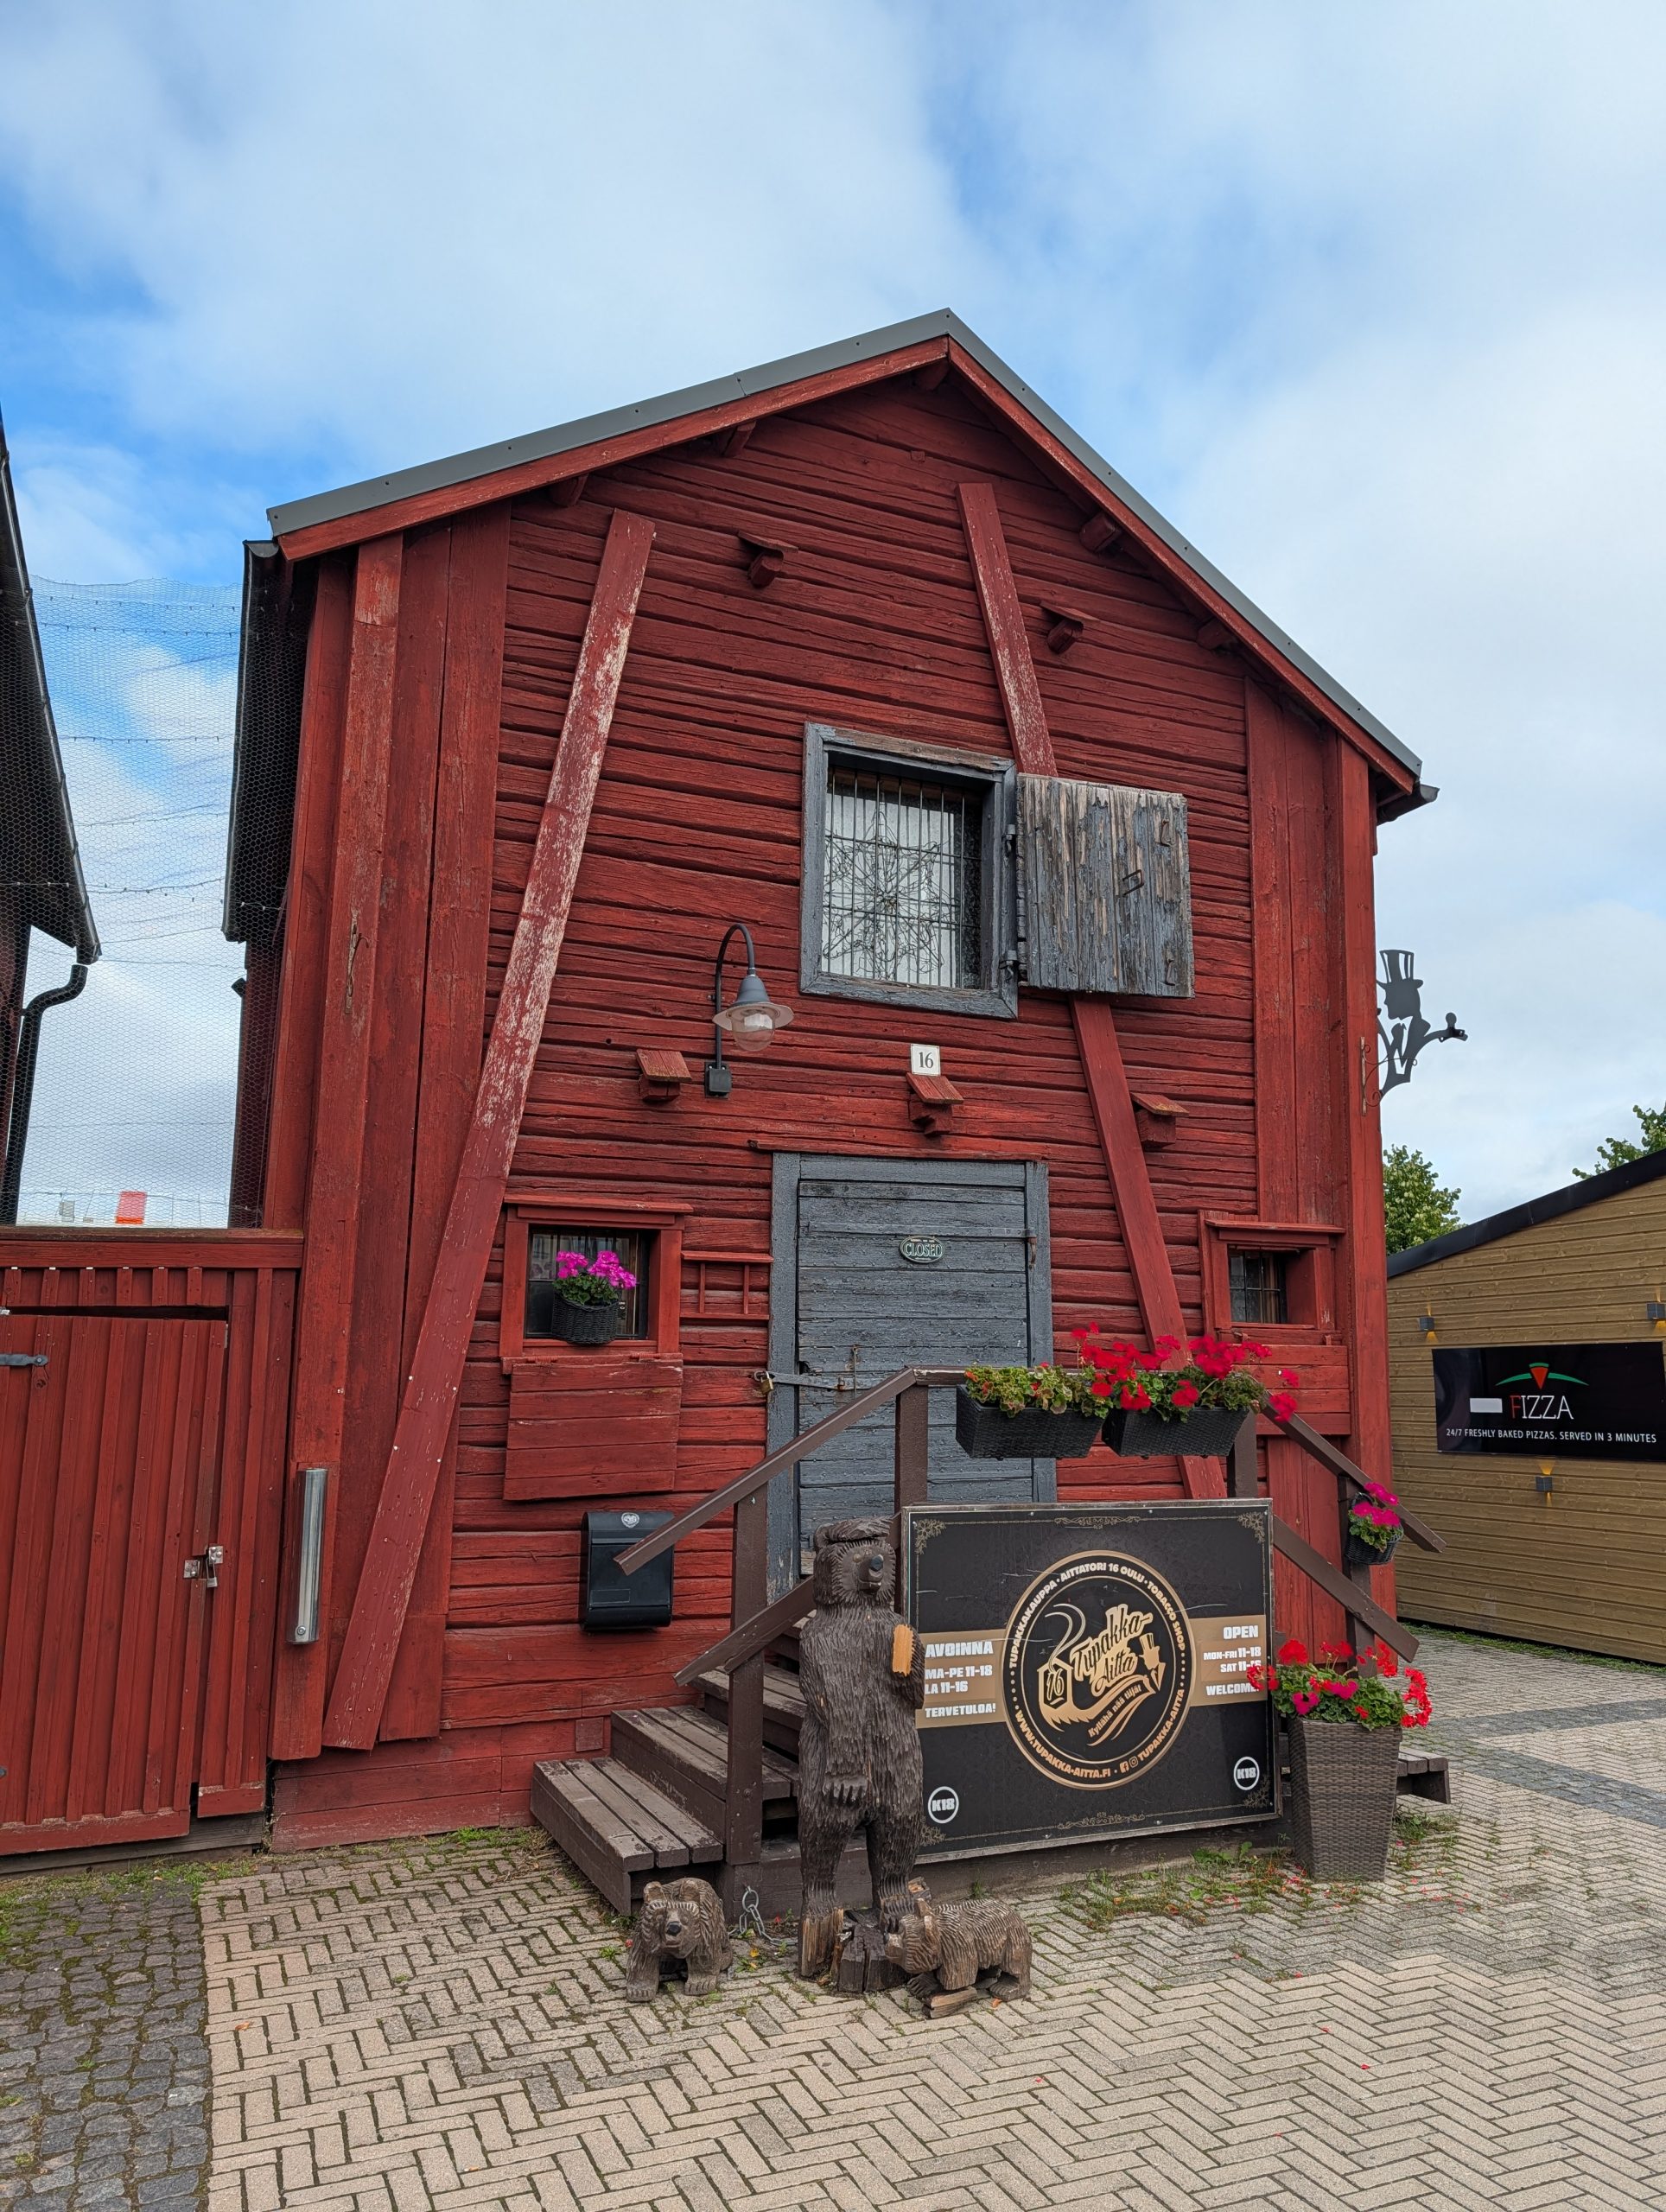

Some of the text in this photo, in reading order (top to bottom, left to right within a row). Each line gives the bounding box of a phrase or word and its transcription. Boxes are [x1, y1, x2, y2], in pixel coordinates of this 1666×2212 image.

[919, 1052, 934, 1069] 16
[905, 1243, 944, 1257] CLOSED
[1510, 1395, 1574, 1420] FIZZA
[1446, 1428, 1656, 1443] 24/7 FRESHLY BAKED PIZZAS. SERVED IN 3 MINUTES
[1009, 1562, 1186, 1669] TUPAKKAKAUPPA AITTATORI 16 OULU TOBACCO SHOP
[1223, 1625, 1259, 1639] OPEN
[925, 1641, 994, 1658] AVOINNA
[1203, 1646, 1262, 1661] MON-FRI 11-18
[925, 1665, 993, 1680] MA-PE 11-18
[1093, 1649, 1136, 1694] Aitta
[1220, 1663, 1237, 1673] SAT
[925, 1681, 968, 1694] LA 11-16
[1046, 1669, 1064, 1700] 16
[925, 1702, 995, 1718] TERVETULOA!
[1138, 1688, 1185, 1762] TUPAKKA-AITTA
[1014, 1709, 1110, 1779] WWW.TUPAKKA-AITTA.FI
[1237, 1767, 1256, 1780] K18
[932, 1798, 955, 1812] K18
